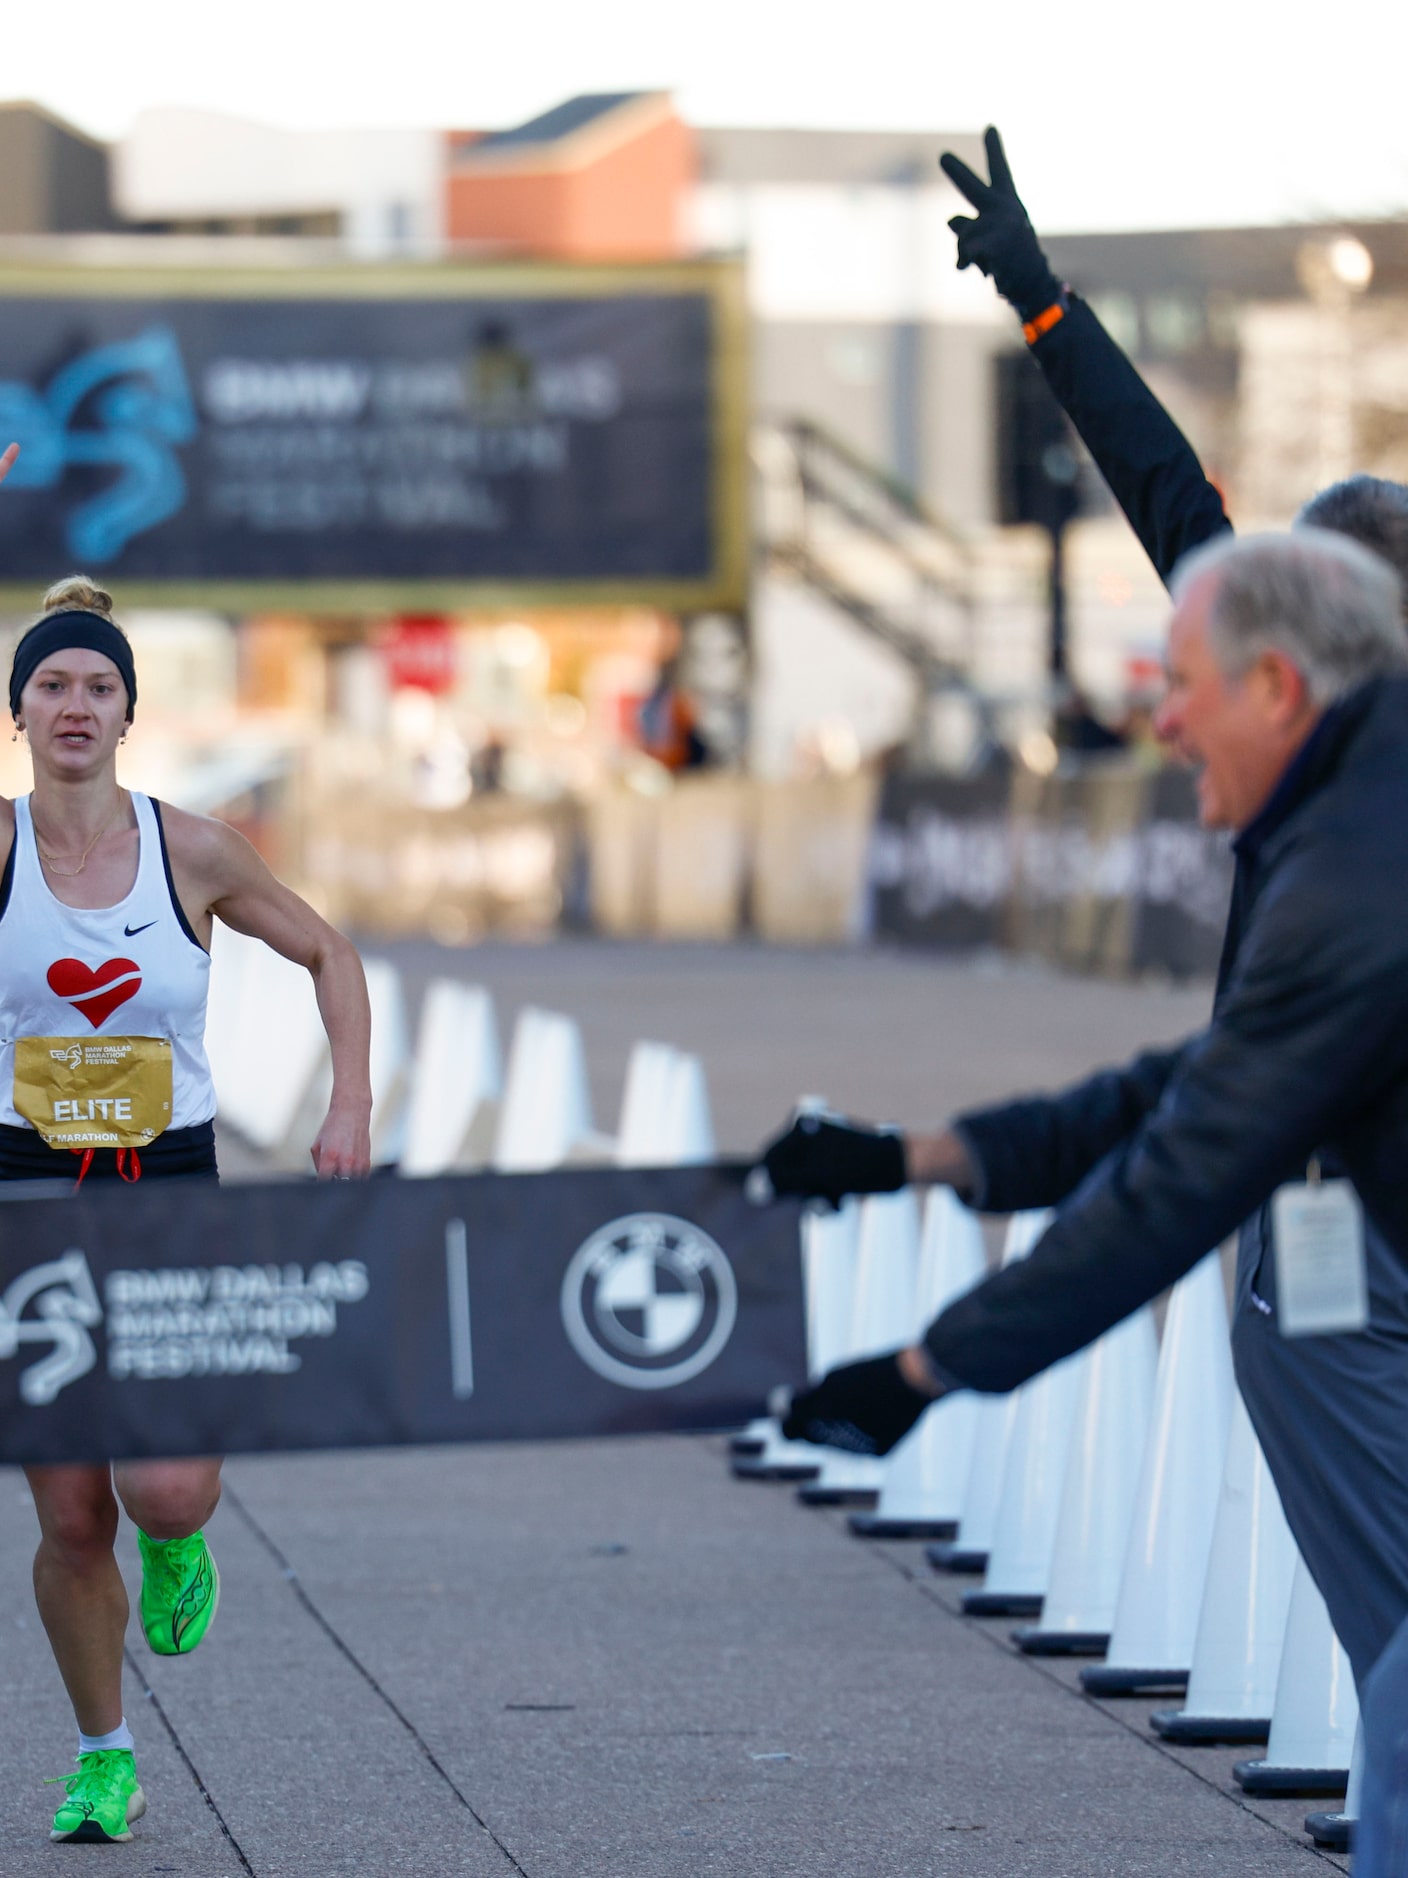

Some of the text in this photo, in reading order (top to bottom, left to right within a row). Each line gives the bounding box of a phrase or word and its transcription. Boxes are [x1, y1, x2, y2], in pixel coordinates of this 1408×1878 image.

[85, 1051, 126, 1059] MARATHON
[103, 1045, 132, 1053] DALLAS
[54, 1098, 133, 1122] ELITE
[57, 1133, 118, 1143] MARATHON
[105, 1260, 369, 1303] BMW DALLAS
[106, 1297, 336, 1339] MARATHON
[108, 1336, 302, 1380] FESTIVAL
